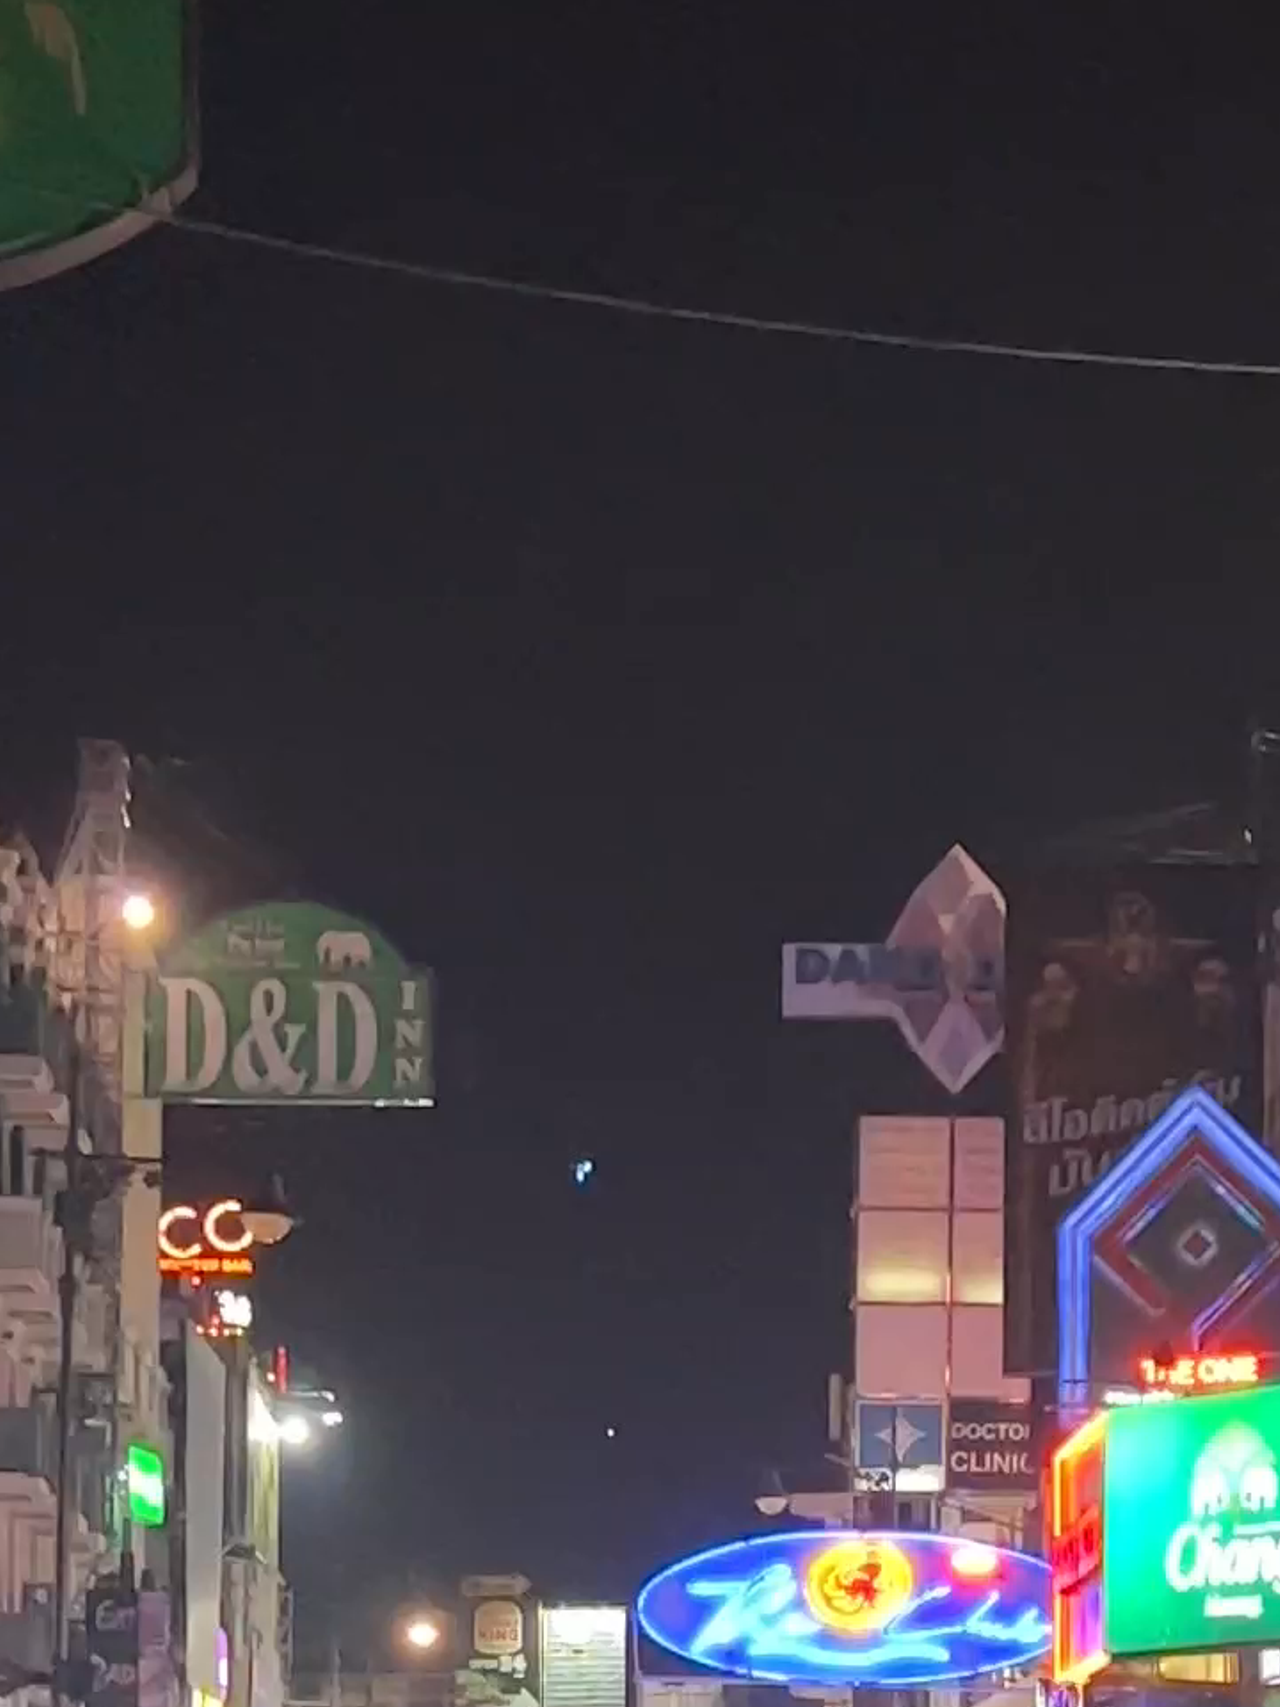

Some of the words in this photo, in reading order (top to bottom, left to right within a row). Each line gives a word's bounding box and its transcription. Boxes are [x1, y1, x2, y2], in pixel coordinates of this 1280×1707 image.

[159, 975, 379, 1096] D&D
[395, 980, 424, 1085] INN
[1198, 1355, 1258, 1383] ONE
